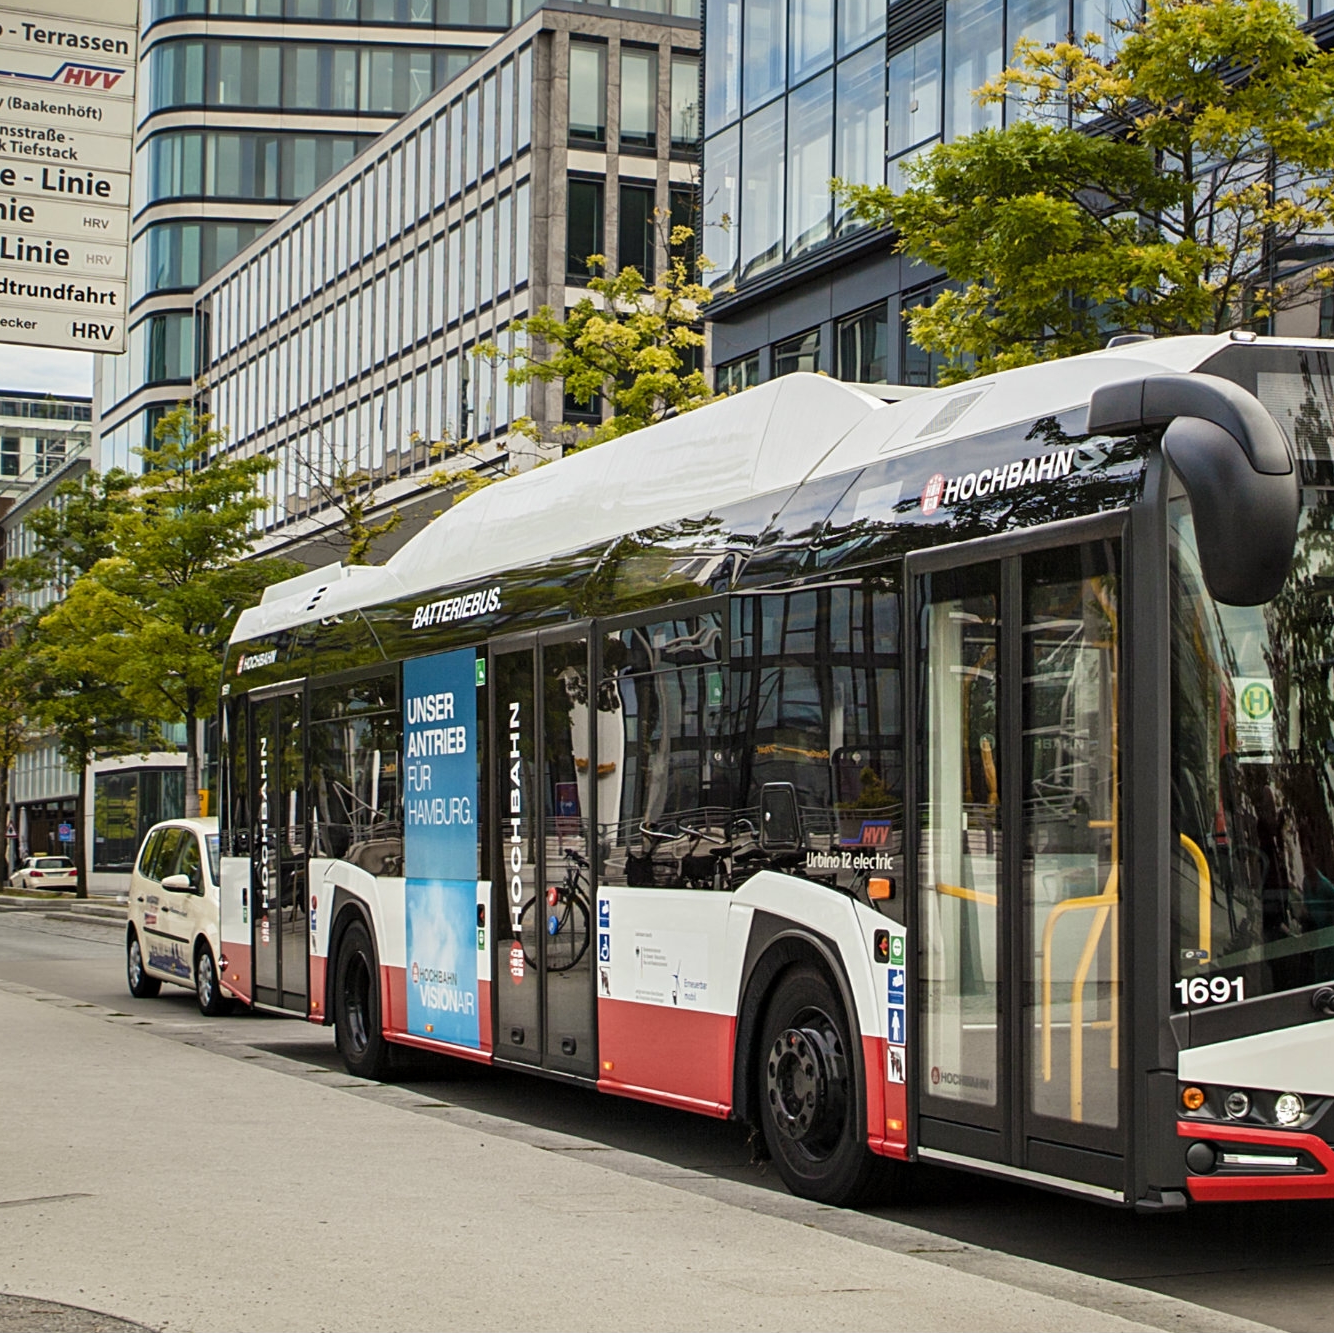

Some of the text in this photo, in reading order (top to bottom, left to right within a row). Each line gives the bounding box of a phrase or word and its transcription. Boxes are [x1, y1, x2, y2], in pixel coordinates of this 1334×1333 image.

[21, 23, 129, 54] Terrassen
[64, 68, 121, 90] HVV
[7, 96, 103, 122] (Baakenhöft)
[9, 140, 78, 161] Tiefstack
[42, 167, 111, 198] Linie
[83, 217, 109, 229] HRV
[86, 253, 112, 266] HRV
[71, 322, 114, 340] HRV
[943, 448, 1075, 504] HOCHBAHN
[412, 587, 501, 629] BATTERIEBUS.
[407, 692, 454, 724] UNSER
[407, 726, 466, 758] ANTRIEB
[408, 761, 431, 792] FÜR
[408, 797, 473, 825] HAMBURG.
[510, 702, 522, 932] HOCHBAHN
[862, 826, 889, 844] HVV
[807, 852, 893, 870] Urbino 12 electric
[420, 967, 457, 986] HOCHBAHN
[420, 984, 474, 1016] VISIONAIR
[1175, 977, 1244, 1004] 1691
